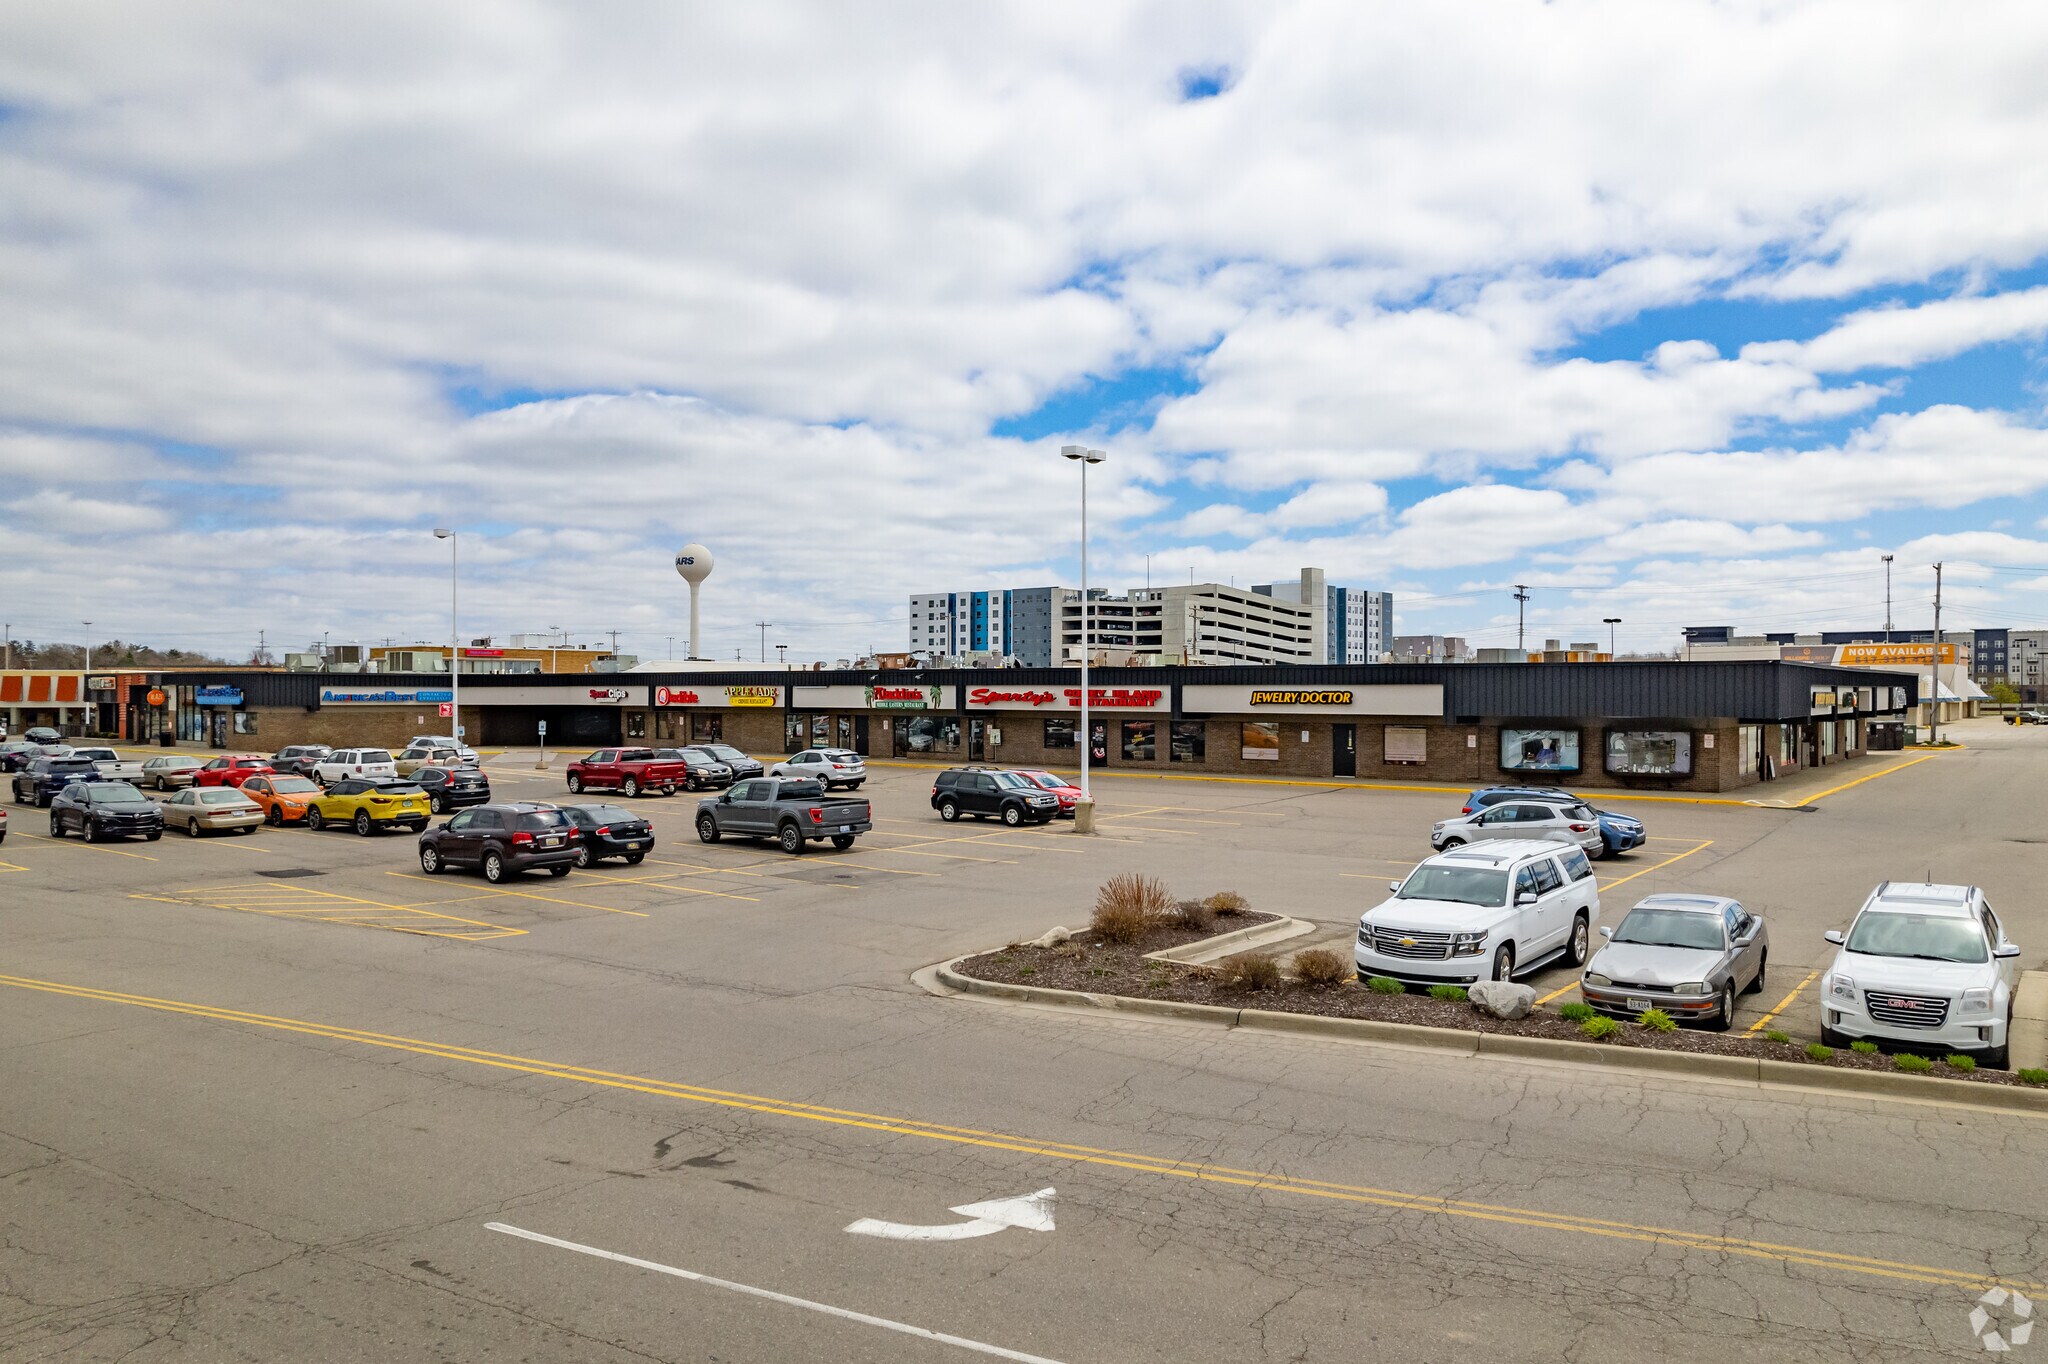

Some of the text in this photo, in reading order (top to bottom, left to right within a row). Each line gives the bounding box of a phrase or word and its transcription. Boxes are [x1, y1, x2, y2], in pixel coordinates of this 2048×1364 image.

[1849, 647, 1949, 656] NOW AVAILABE
[725, 687, 778, 697] APPLE JADE
[1064, 689, 1162, 699] COEY ISLAND
[969, 689, 1056, 706] Sparty's
[1251, 692, 1351, 705] JEWELRY DOCTOR
[1888, 999, 1925, 1010] GMC
